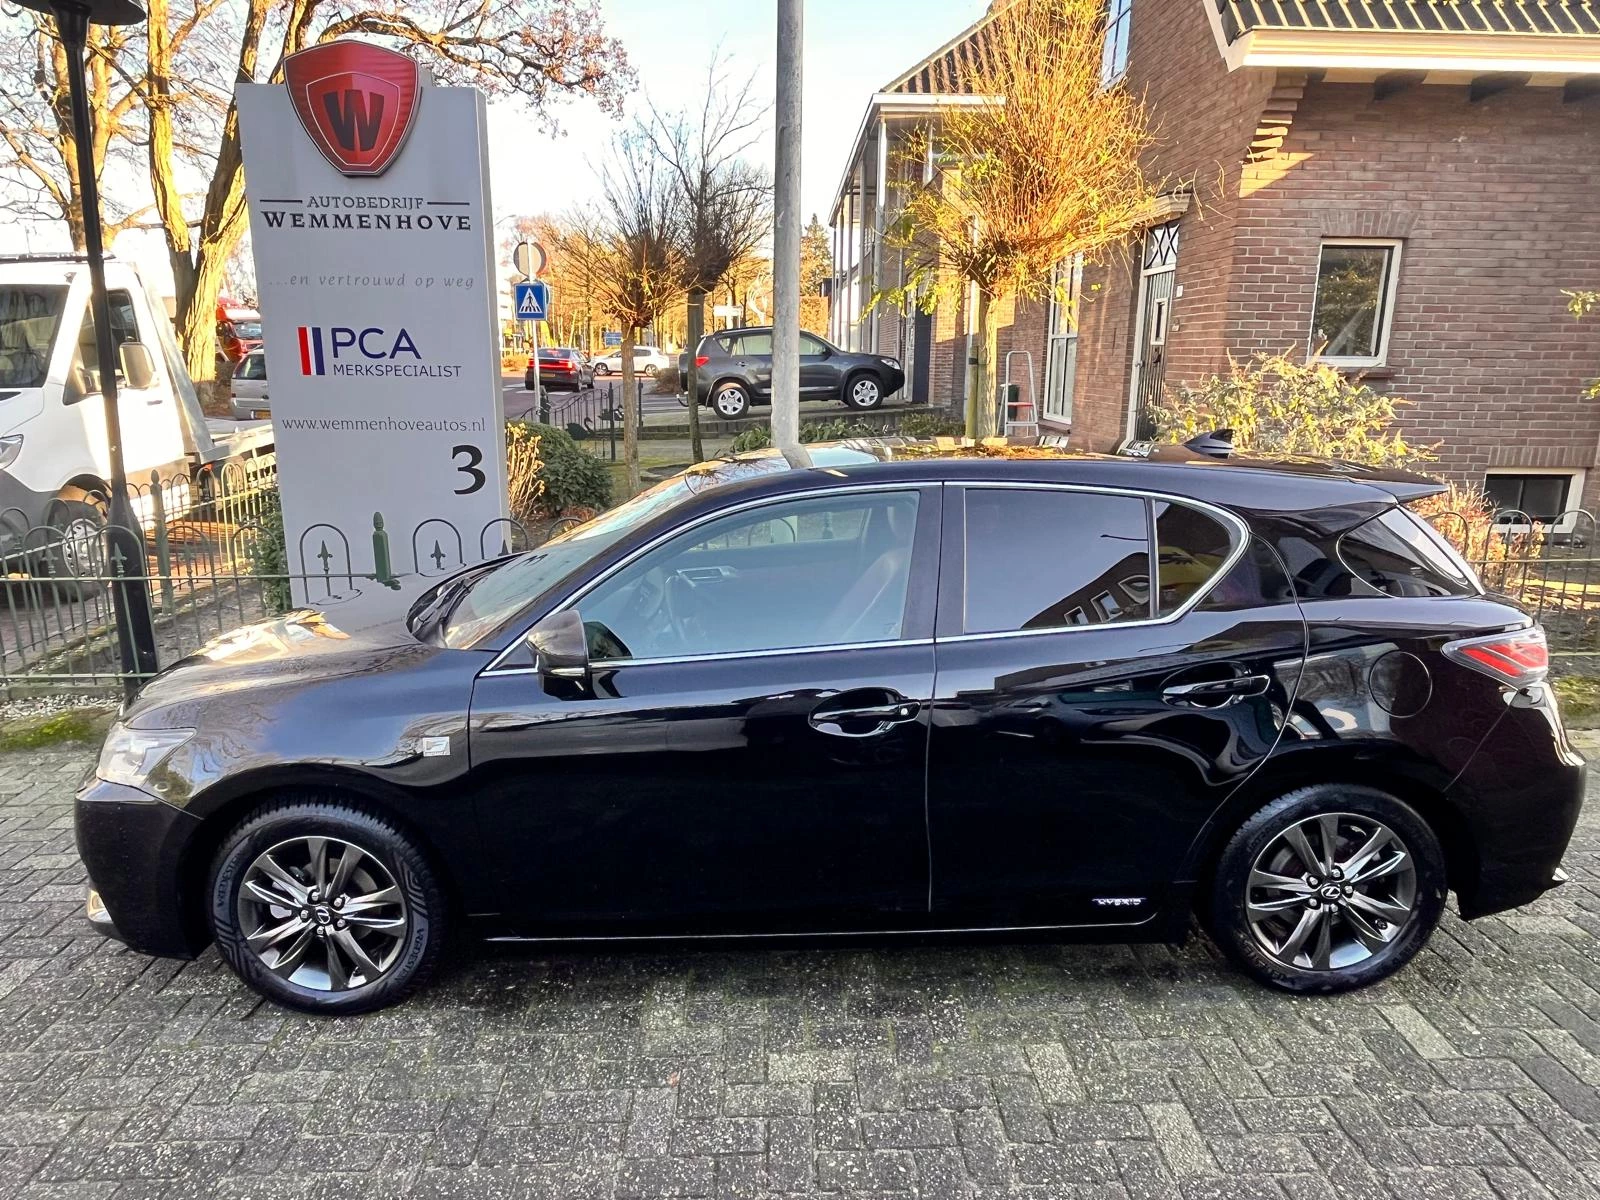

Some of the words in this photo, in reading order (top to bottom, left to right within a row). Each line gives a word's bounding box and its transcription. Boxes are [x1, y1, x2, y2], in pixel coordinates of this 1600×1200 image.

[306, 195, 424, 210] AUTOBEDRIJF
[260, 210, 471, 231] WEMMENHOVE
[319, 273, 405, 287] vertrouwd
[415, 275, 435, 288] op
[444, 276, 475, 290] weg
[330, 327, 422, 360] PCA
[333, 364, 462, 378] MERKSPECIALIST
[282, 417, 486, 432] www.wemmenhoveautos.nl
[452, 444, 486, 495] 3
